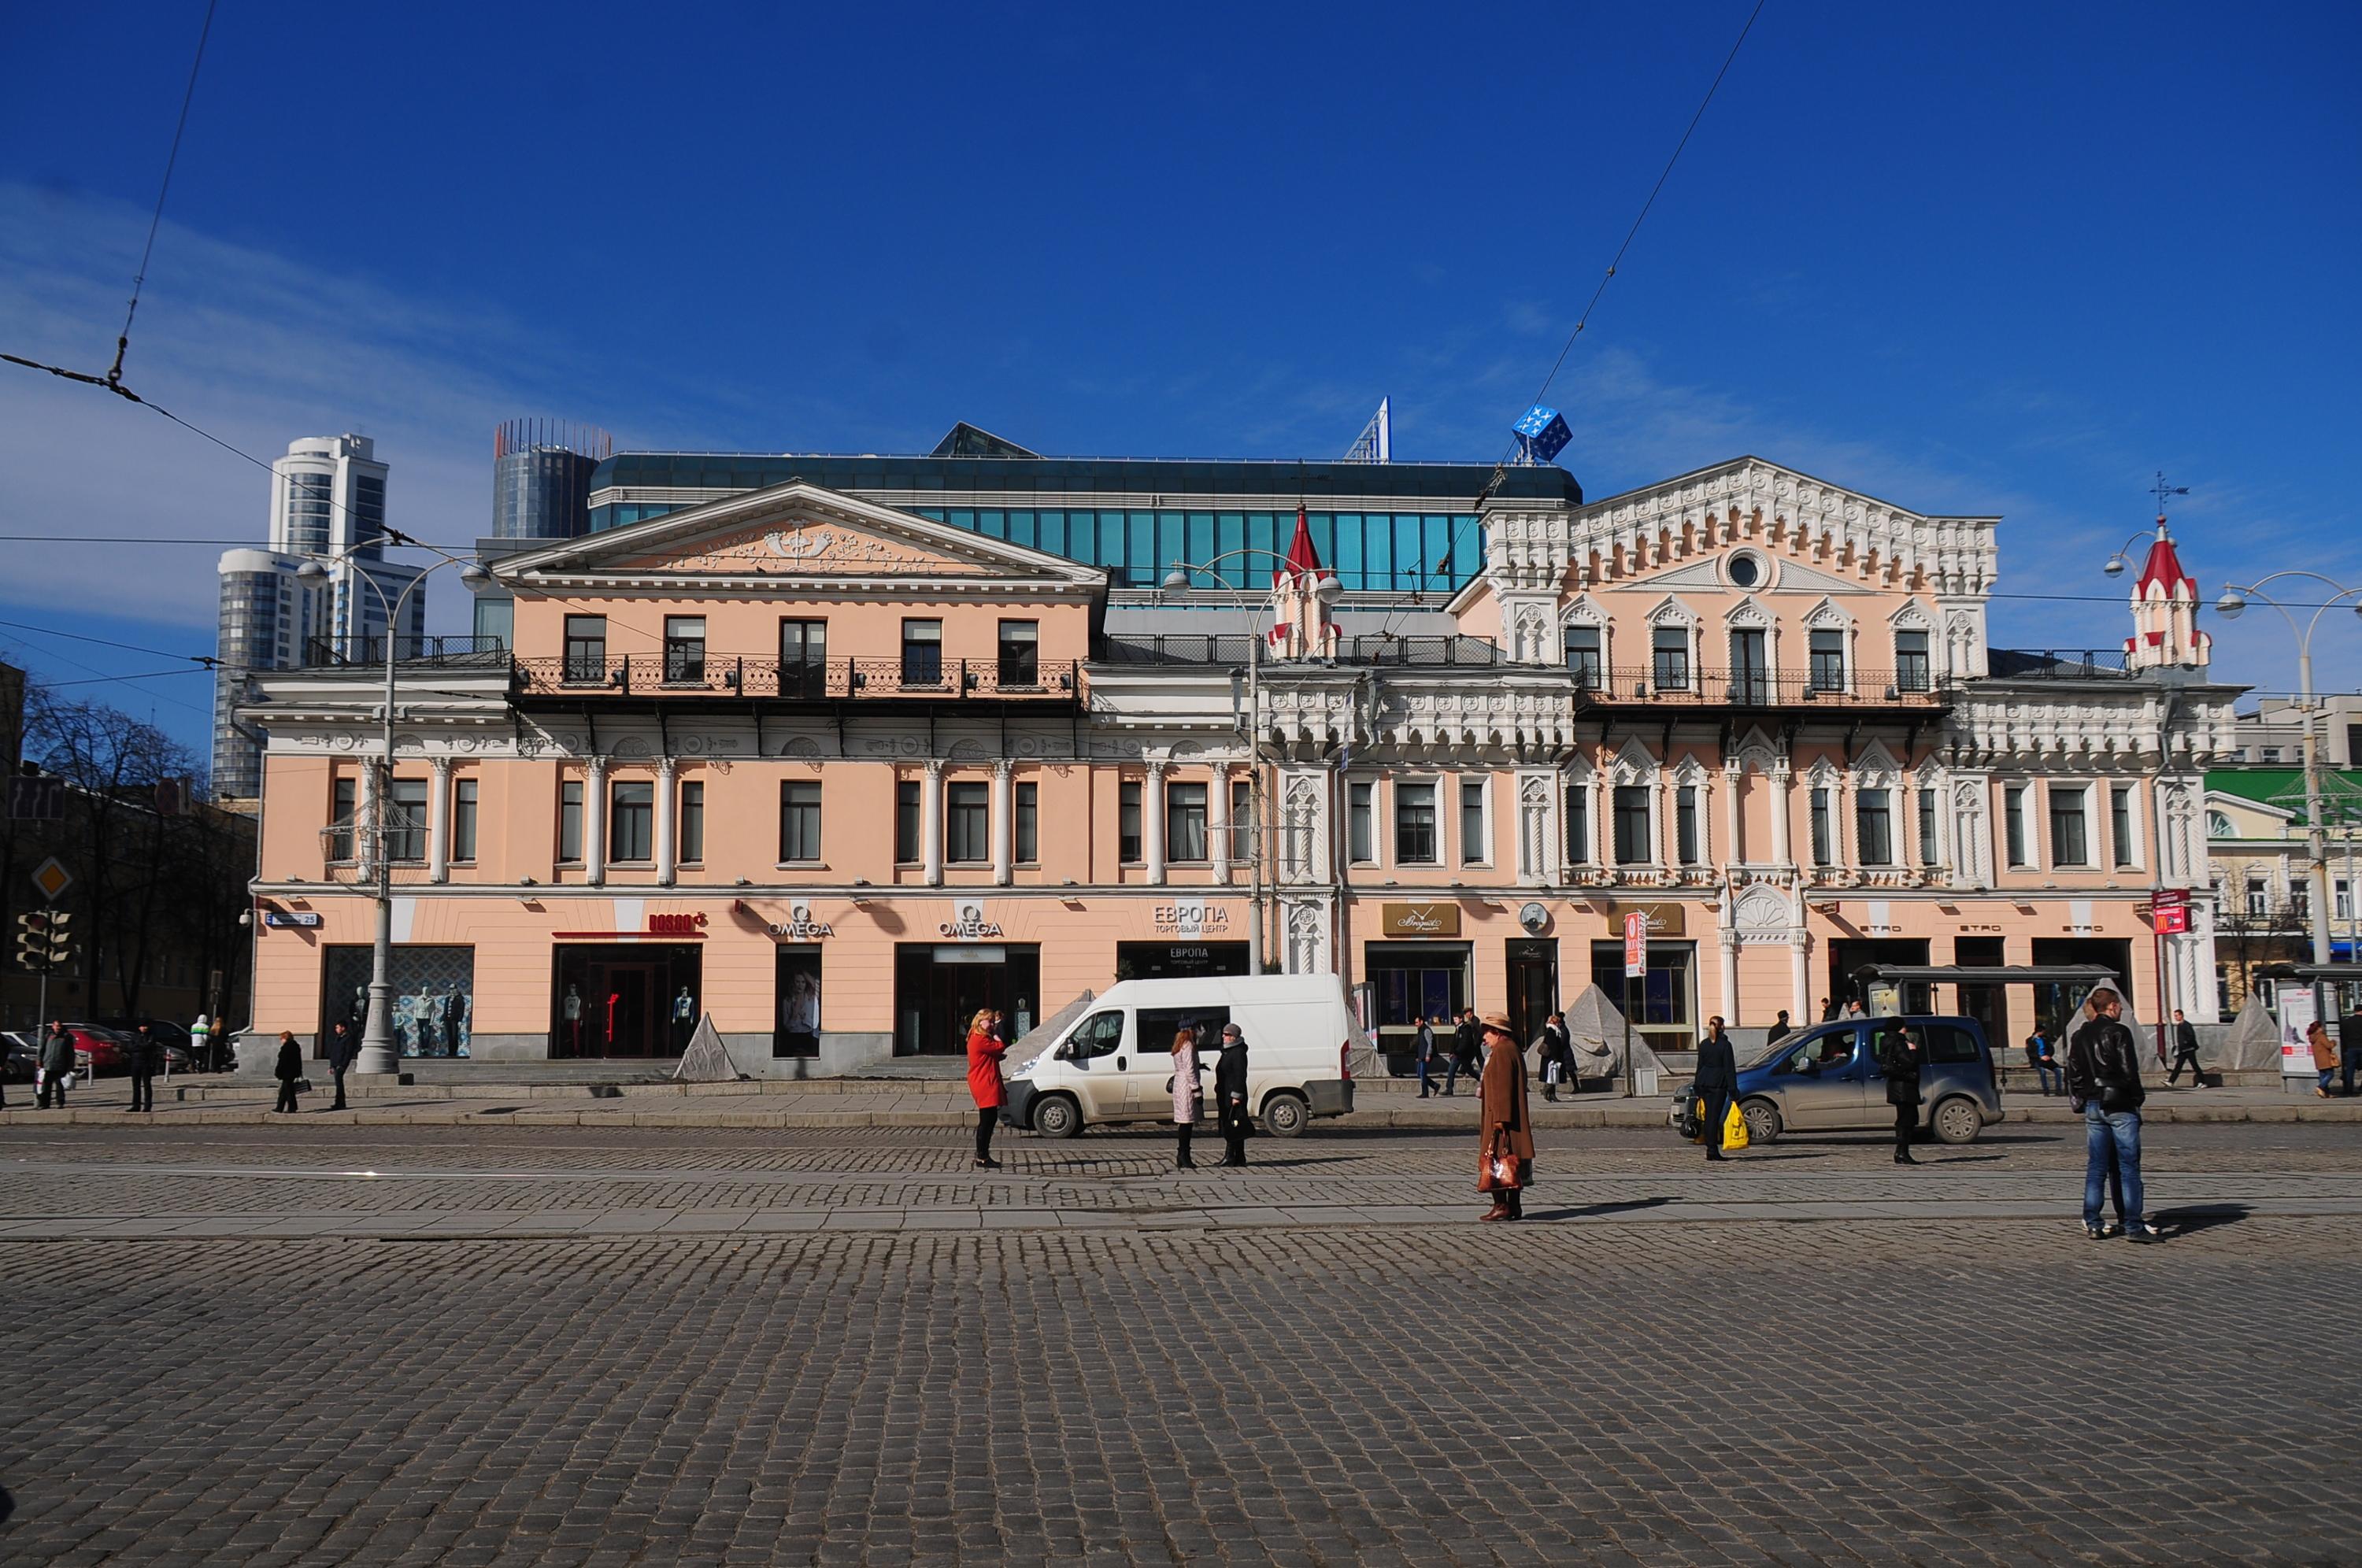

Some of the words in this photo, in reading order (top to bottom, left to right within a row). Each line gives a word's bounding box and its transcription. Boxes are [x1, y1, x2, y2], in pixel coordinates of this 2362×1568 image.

[1155, 907, 1229, 923] ЕВРОПА
[650, 914, 691, 931] BOSCO
[768, 923, 832, 935] OMEGA
[939, 923, 1001, 935] OMEGA
[1154, 924, 1200, 934] ТОРГОВЫЙ
[1201, 925, 1228, 934] ЦЕНТР
[1170, 948, 1209, 958] ЕВРОПА
